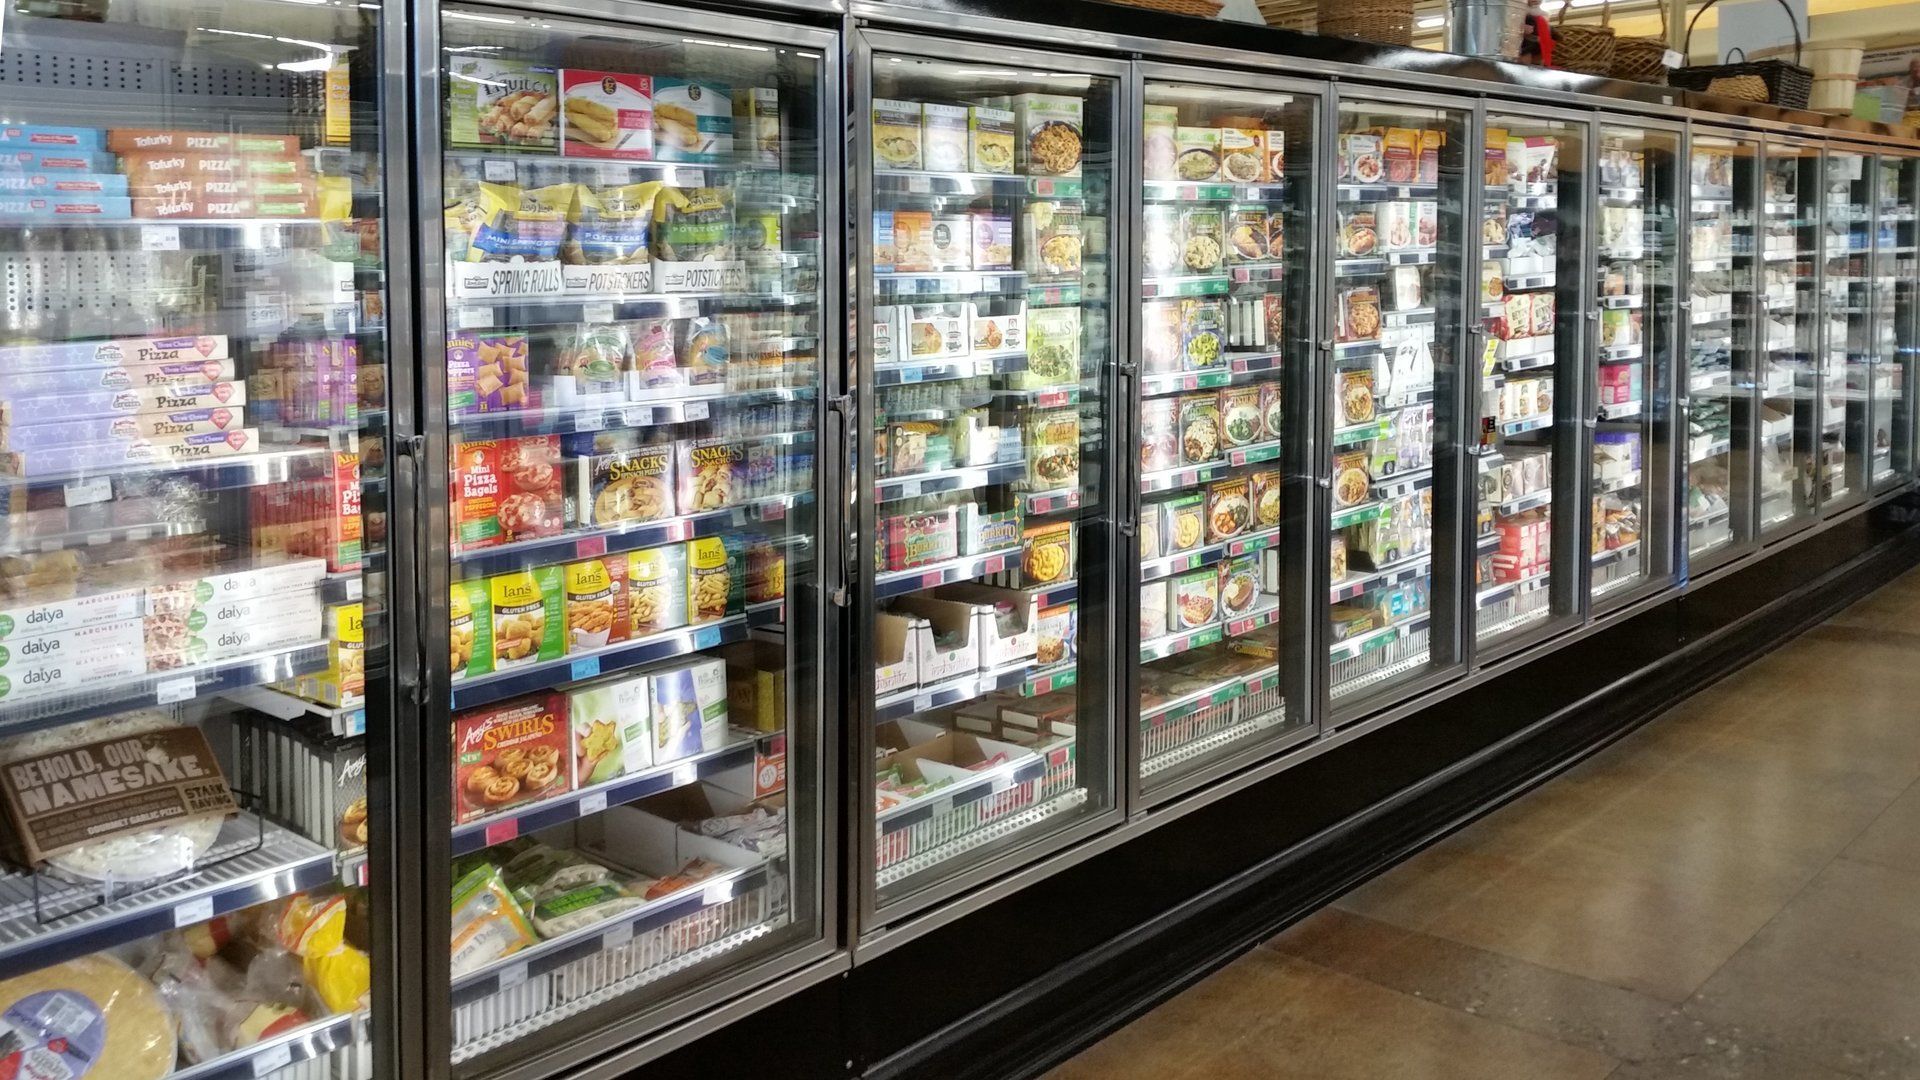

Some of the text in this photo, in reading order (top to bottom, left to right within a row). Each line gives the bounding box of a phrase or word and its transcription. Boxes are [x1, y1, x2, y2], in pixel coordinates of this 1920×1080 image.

[134, 135, 220, 149] Tofurky PIZZA
[147, 158, 232, 171] Tofurky PIZZA
[154, 181, 238, 195] Tofurky PIZZA
[207, 203, 241, 214] PIZZA
[491, 267, 560, 294] SPRING ROLLS
[685, 269, 742, 288] POTSTICKERS
[138, 348, 179, 361] Pizza
[156, 396, 197, 409] Pizza
[154, 421, 194, 434] Pizza
[169, 444, 210, 457] Pizza
[691, 443, 744, 468] SNACKS
[471, 465, 490, 475] Mini
[610, 455, 668, 481] SNACKS
[464, 474, 497, 487] Pizza
[464, 484, 498, 498] Bagels
[979, 524, 1015, 542] BURRITO
[909, 536, 949, 558] BURRITO
[576, 572, 602, 585] Ian's
[503, 584, 532, 598] Ian's
[575, 590, 610, 601] GLUTEN FREE
[78, 592, 136, 606] MARGHERITA
[217, 604, 250, 621] daiya
[526, 602, 541, 612] FREE
[26, 607, 64, 624] daiya
[455, 616, 469, 625] FREE
[75, 622, 134, 637] MARGHERITA
[21, 638, 60, 655] daiya
[217, 632, 250, 647] daiya
[23, 667, 61, 685] daiya
[461, 716, 493, 753] Amy's
[484, 713, 555, 751] SWIRLS
[104, 739, 147, 768] OUR
[338, 753, 367, 787] Amy
[20, 754, 210, 816] NAMESAKE.
[159, 806, 184, 817] PIZZA
